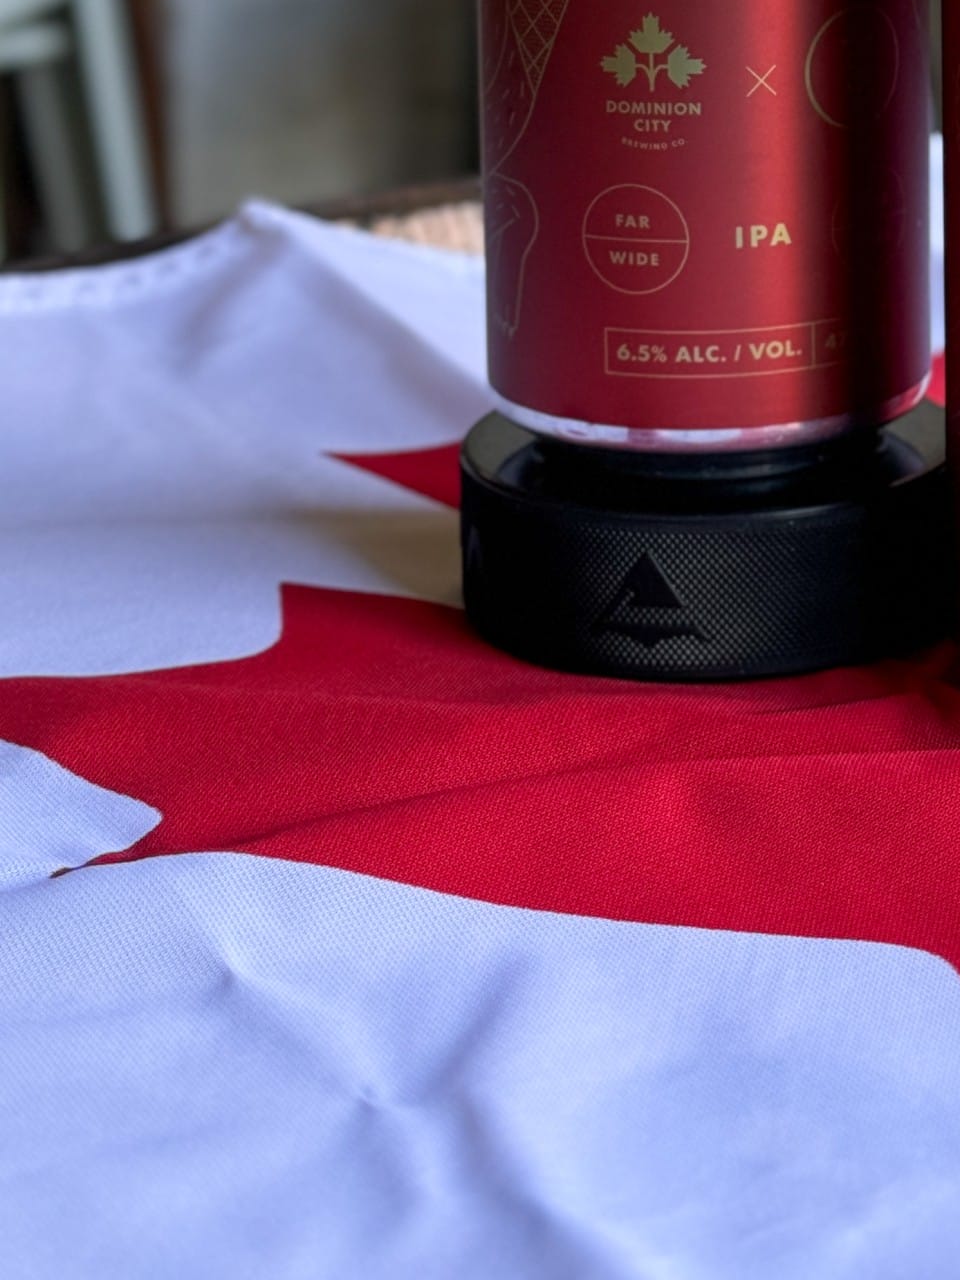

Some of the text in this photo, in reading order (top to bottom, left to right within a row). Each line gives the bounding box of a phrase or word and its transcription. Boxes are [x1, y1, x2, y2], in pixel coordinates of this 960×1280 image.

[606, 100, 702, 117] DOMINION
[634, 118, 672, 133] CITY
[615, 213, 651, 230] FAR
[735, 223, 792, 250] IPA
[609, 251, 661, 267] WIDE
[616, 343, 667, 362] 6.5%
[675, 345, 727, 363] ALC.
[748, 339, 802, 360] VOL.
